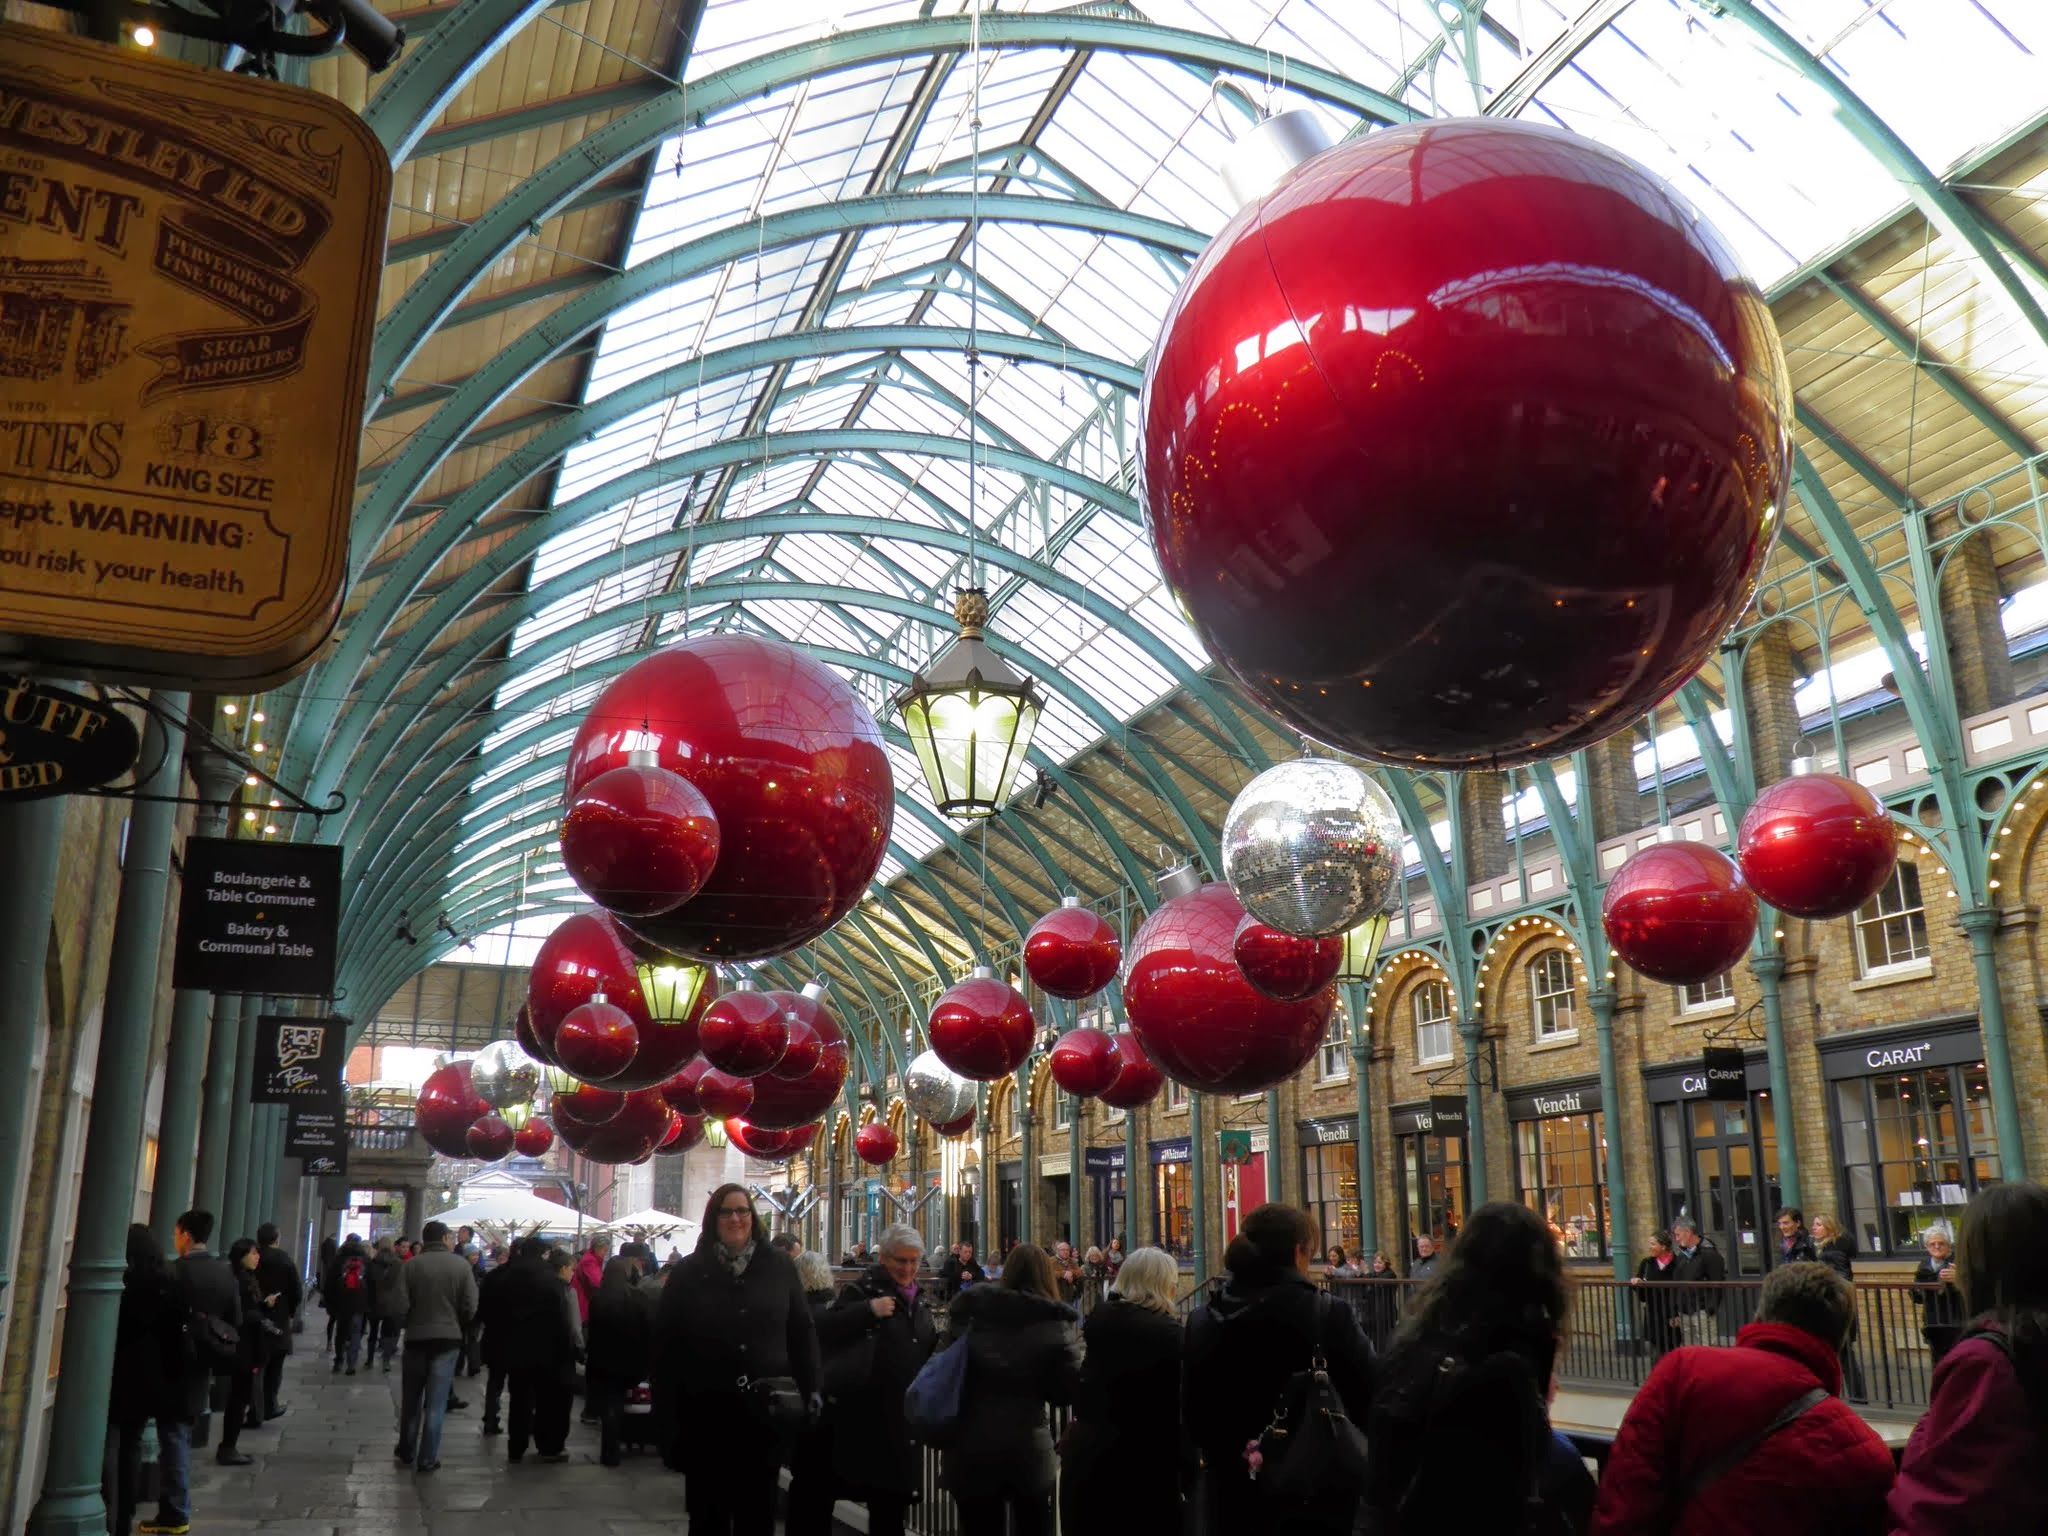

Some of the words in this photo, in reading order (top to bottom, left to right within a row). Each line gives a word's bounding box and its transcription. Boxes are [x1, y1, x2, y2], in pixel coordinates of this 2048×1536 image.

[220, 171, 307, 236] LTD
[167, 232, 268, 292] PURVEYORS
[267, 285, 292, 304] OF
[162, 251, 205, 281] FINE
[207, 272, 275, 318] TOBACCO
[201, 334, 271, 359] SEGAR
[183, 346, 295, 381] IMPORTERS
[0, 420, 124, 480] TES
[145, 461, 212, 493] KING
[216, 471, 275, 502] SIZE
[37, 549, 86, 574] risk
[95, 559, 156, 584] your
[161, 560, 245, 595] health
[213, 871, 296, 890] Boulangerie
[298, 876, 312, 888] &
[206, 889, 243, 903] Table
[245, 891, 316, 907] Commune
[227, 922, 275, 940] Bakery
[276, 924, 290, 937] &
[199, 939, 276, 955] Communal
[277, 943, 315, 957] Table
[276, 1066, 319, 1087] Pain
[1533, 1092, 1582, 1115] Venchi
[1436, 1111, 1464, 1121] Venchi
[1316, 1125, 1350, 1143] Venchi
